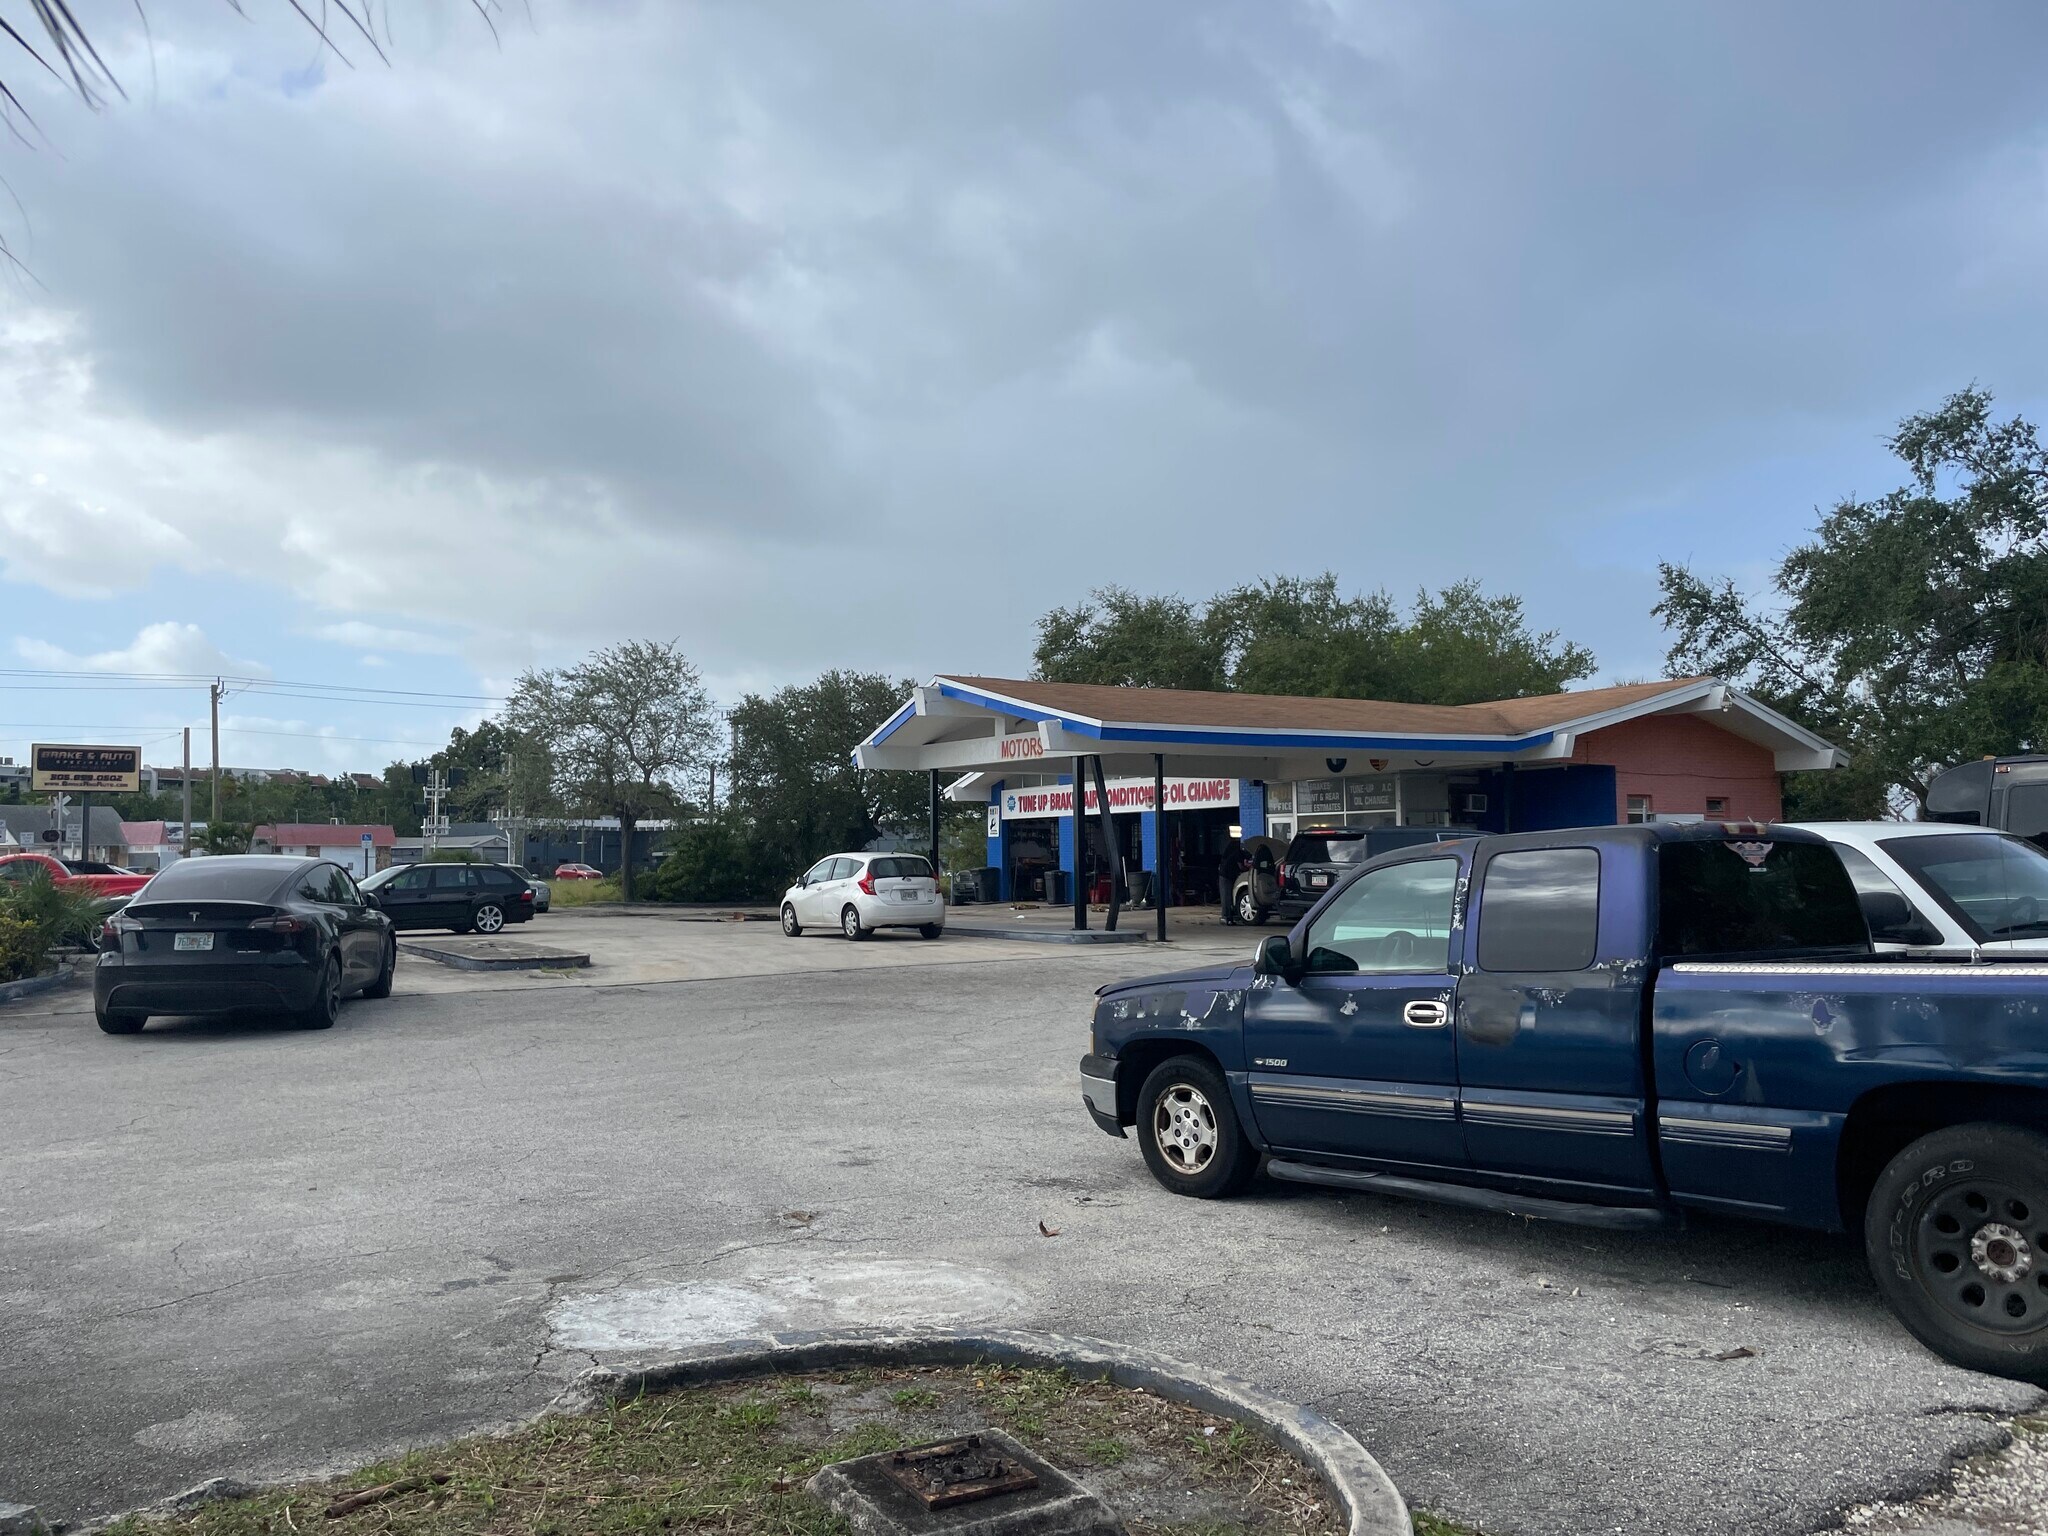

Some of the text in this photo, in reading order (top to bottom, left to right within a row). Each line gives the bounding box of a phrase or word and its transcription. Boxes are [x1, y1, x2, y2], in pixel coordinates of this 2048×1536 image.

[1001, 737, 1043, 758] MOTORS
[41, 751, 83, 760] BRAKE
[87, 752, 96, 760] &
[1018, 795, 1037, 813] TUNE
[1038, 795, 1048, 812] UP
[1084, 790, 1098, 809] AIR
[1170, 783, 1187, 803] OIL
[1188, 779, 1230, 802] CHANGE
[1364, 795, 1390, 805] CHANGE
[1265, 1058, 1288, 1067] 1500
